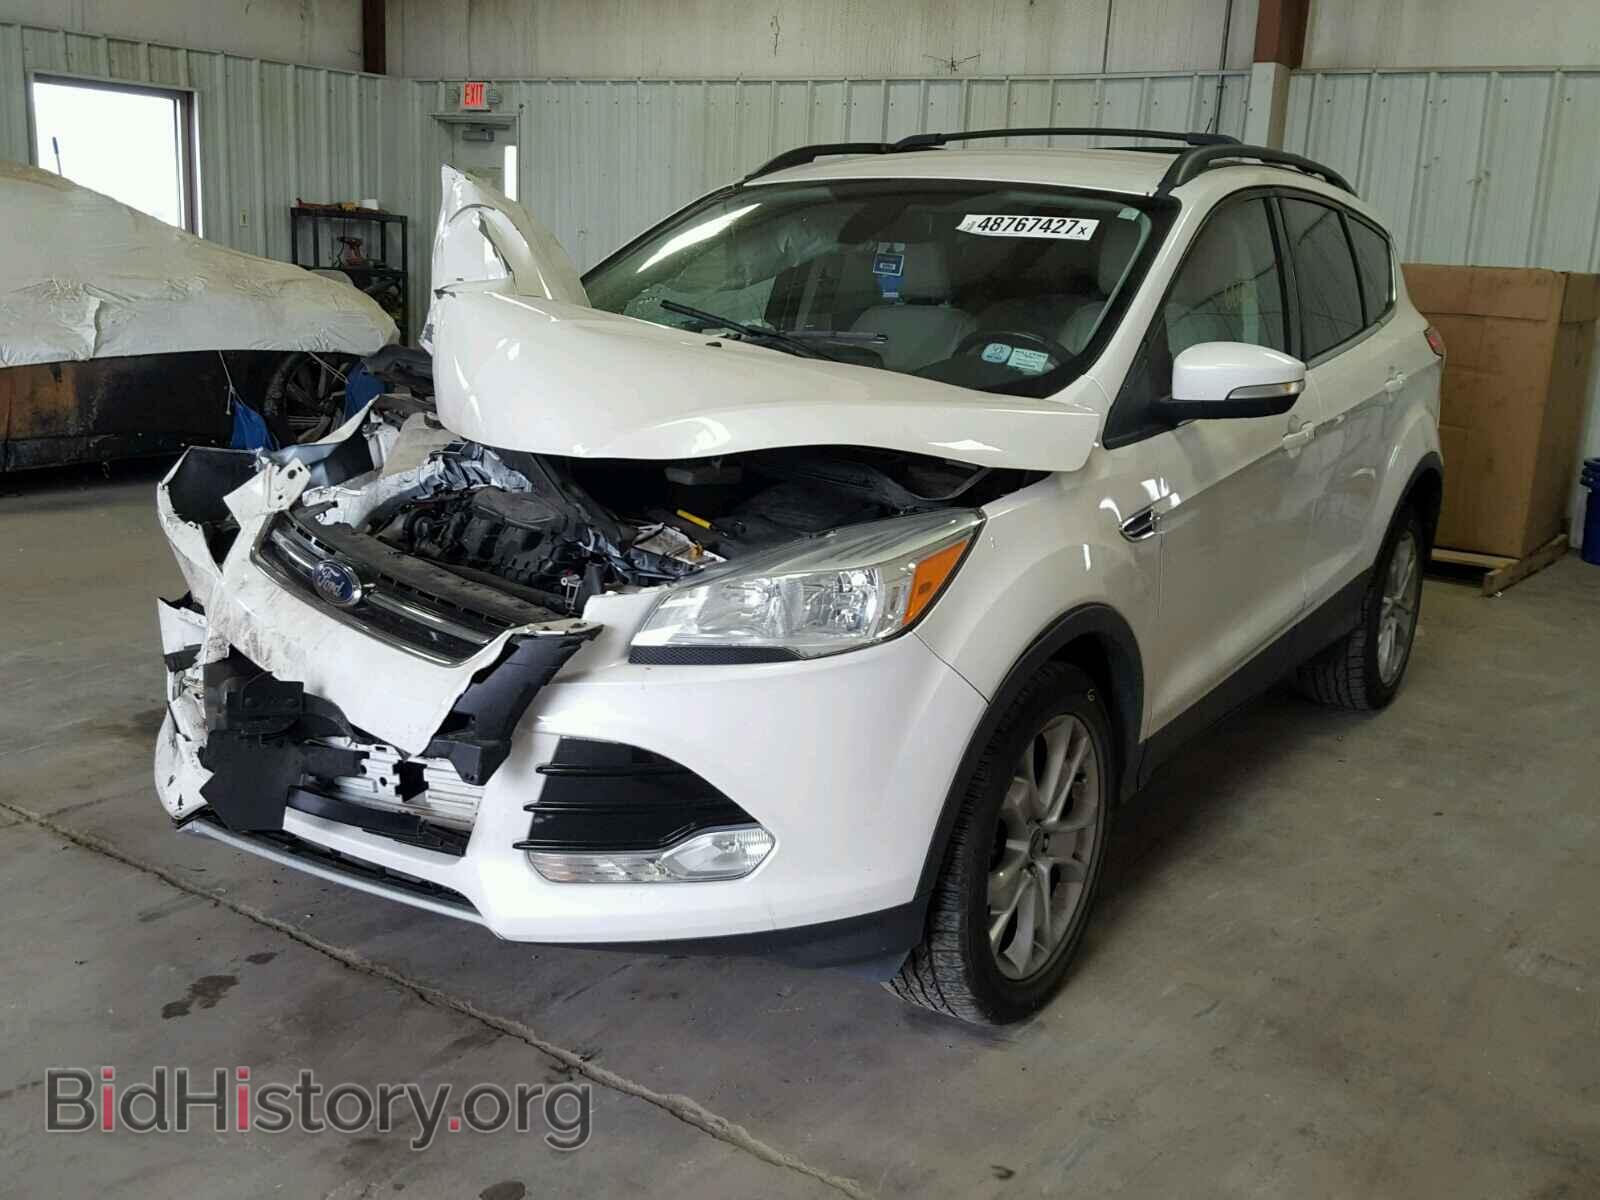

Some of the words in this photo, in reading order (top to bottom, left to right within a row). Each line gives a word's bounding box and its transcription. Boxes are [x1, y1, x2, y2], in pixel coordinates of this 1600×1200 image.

[464, 83, 485, 105] EXIT
[977, 216, 1080, 234] 48767427
[321, 566, 346, 599] Ford
